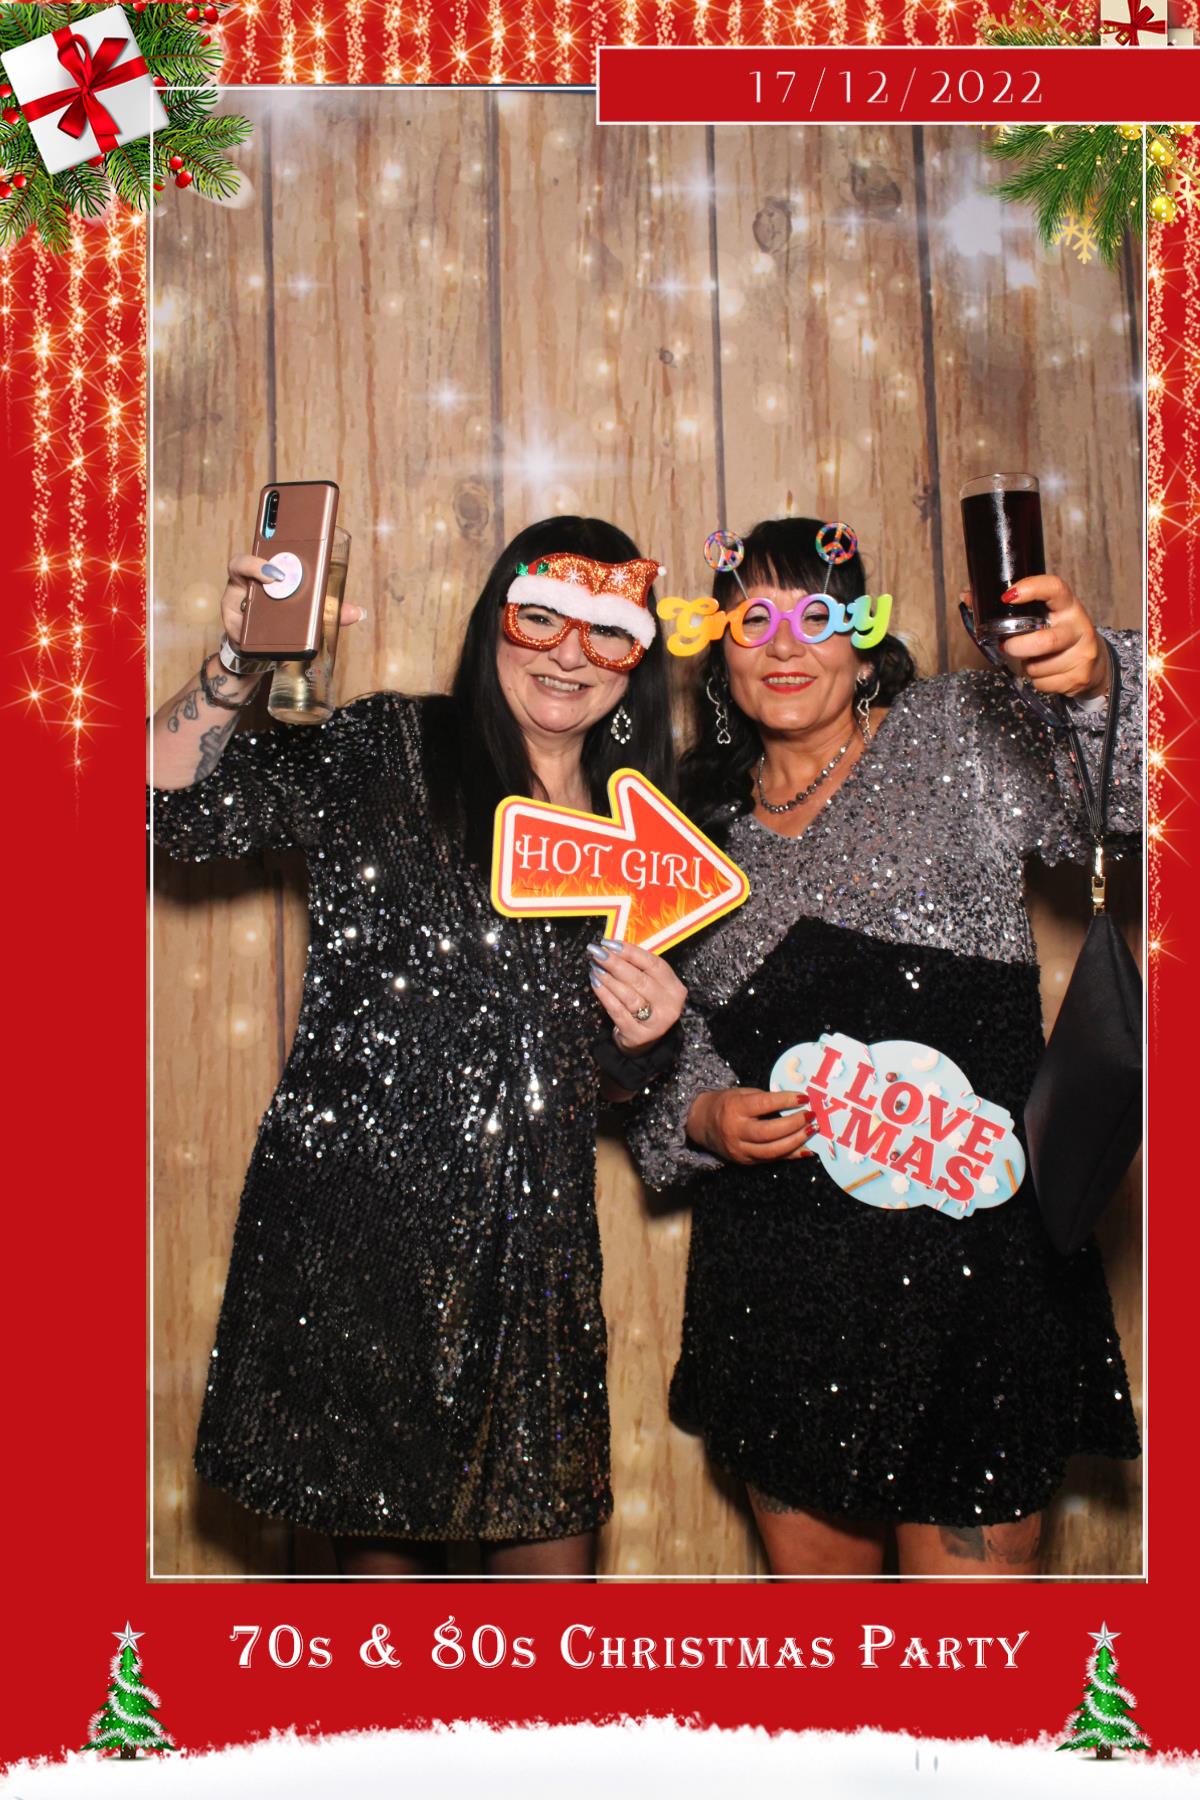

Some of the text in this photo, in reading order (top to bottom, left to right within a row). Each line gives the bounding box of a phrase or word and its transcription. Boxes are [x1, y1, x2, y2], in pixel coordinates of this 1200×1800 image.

[515, 834, 713, 898] HOT GIRL
[805, 1085, 985, 1201] XMAS
[809, 1046, 1006, 1165] I LOVE
